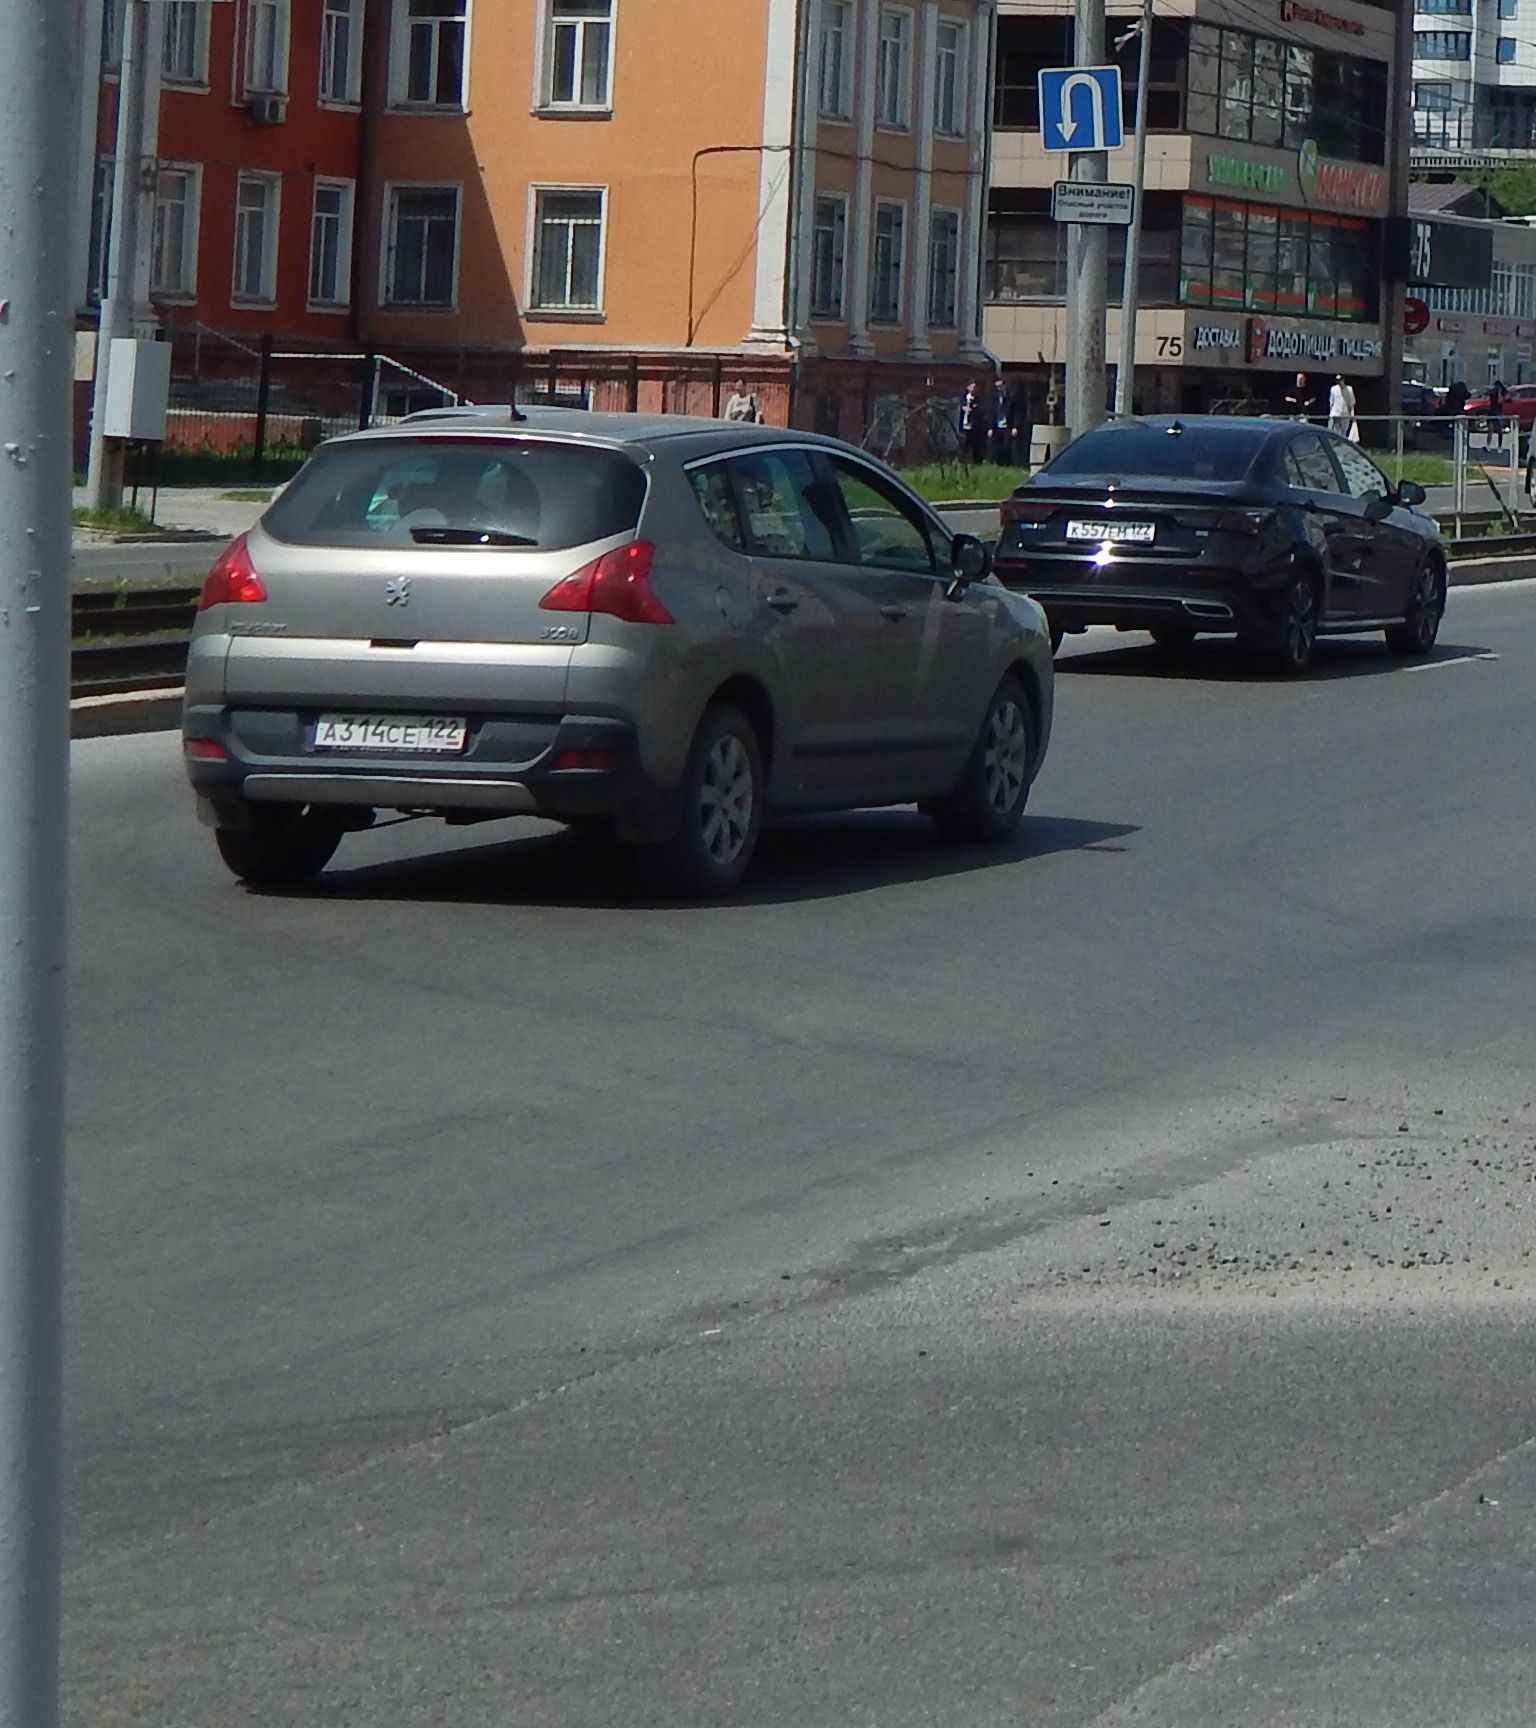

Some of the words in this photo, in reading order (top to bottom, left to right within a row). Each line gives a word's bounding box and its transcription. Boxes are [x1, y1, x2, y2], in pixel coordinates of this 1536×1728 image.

[1156, 336, 1182, 357] 75
[323, 718, 417, 745] А314СЕ
[425, 719, 459, 739] 122
